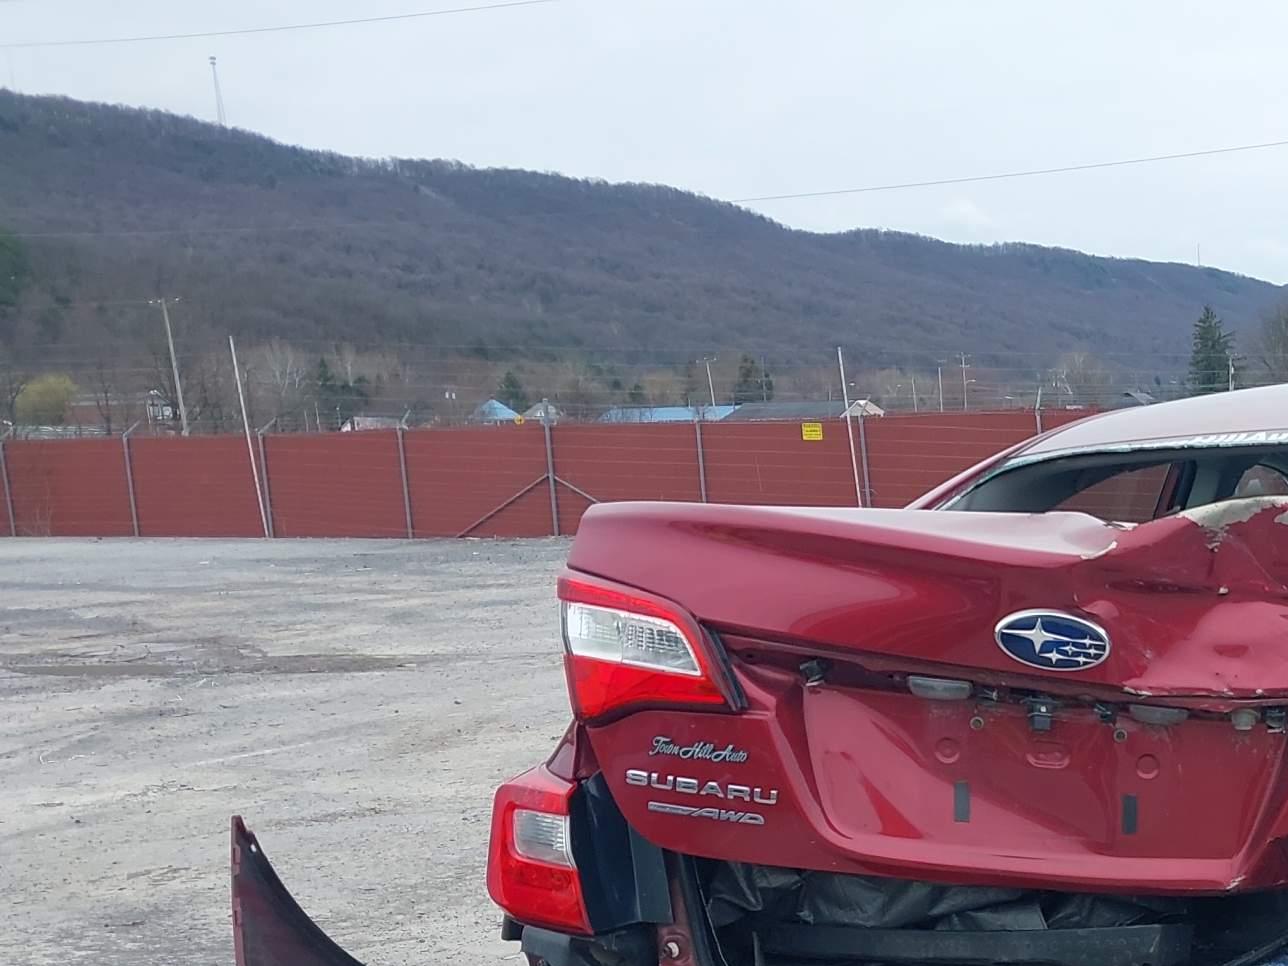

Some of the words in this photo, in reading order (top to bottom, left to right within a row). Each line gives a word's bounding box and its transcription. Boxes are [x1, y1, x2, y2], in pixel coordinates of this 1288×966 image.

[648, 736, 680, 756] Town
[680, 741, 712, 759] Hill
[711, 744, 748, 762] Auto
[625, 769, 779, 805] SUBARU
[692, 808, 765, 825] AWD
